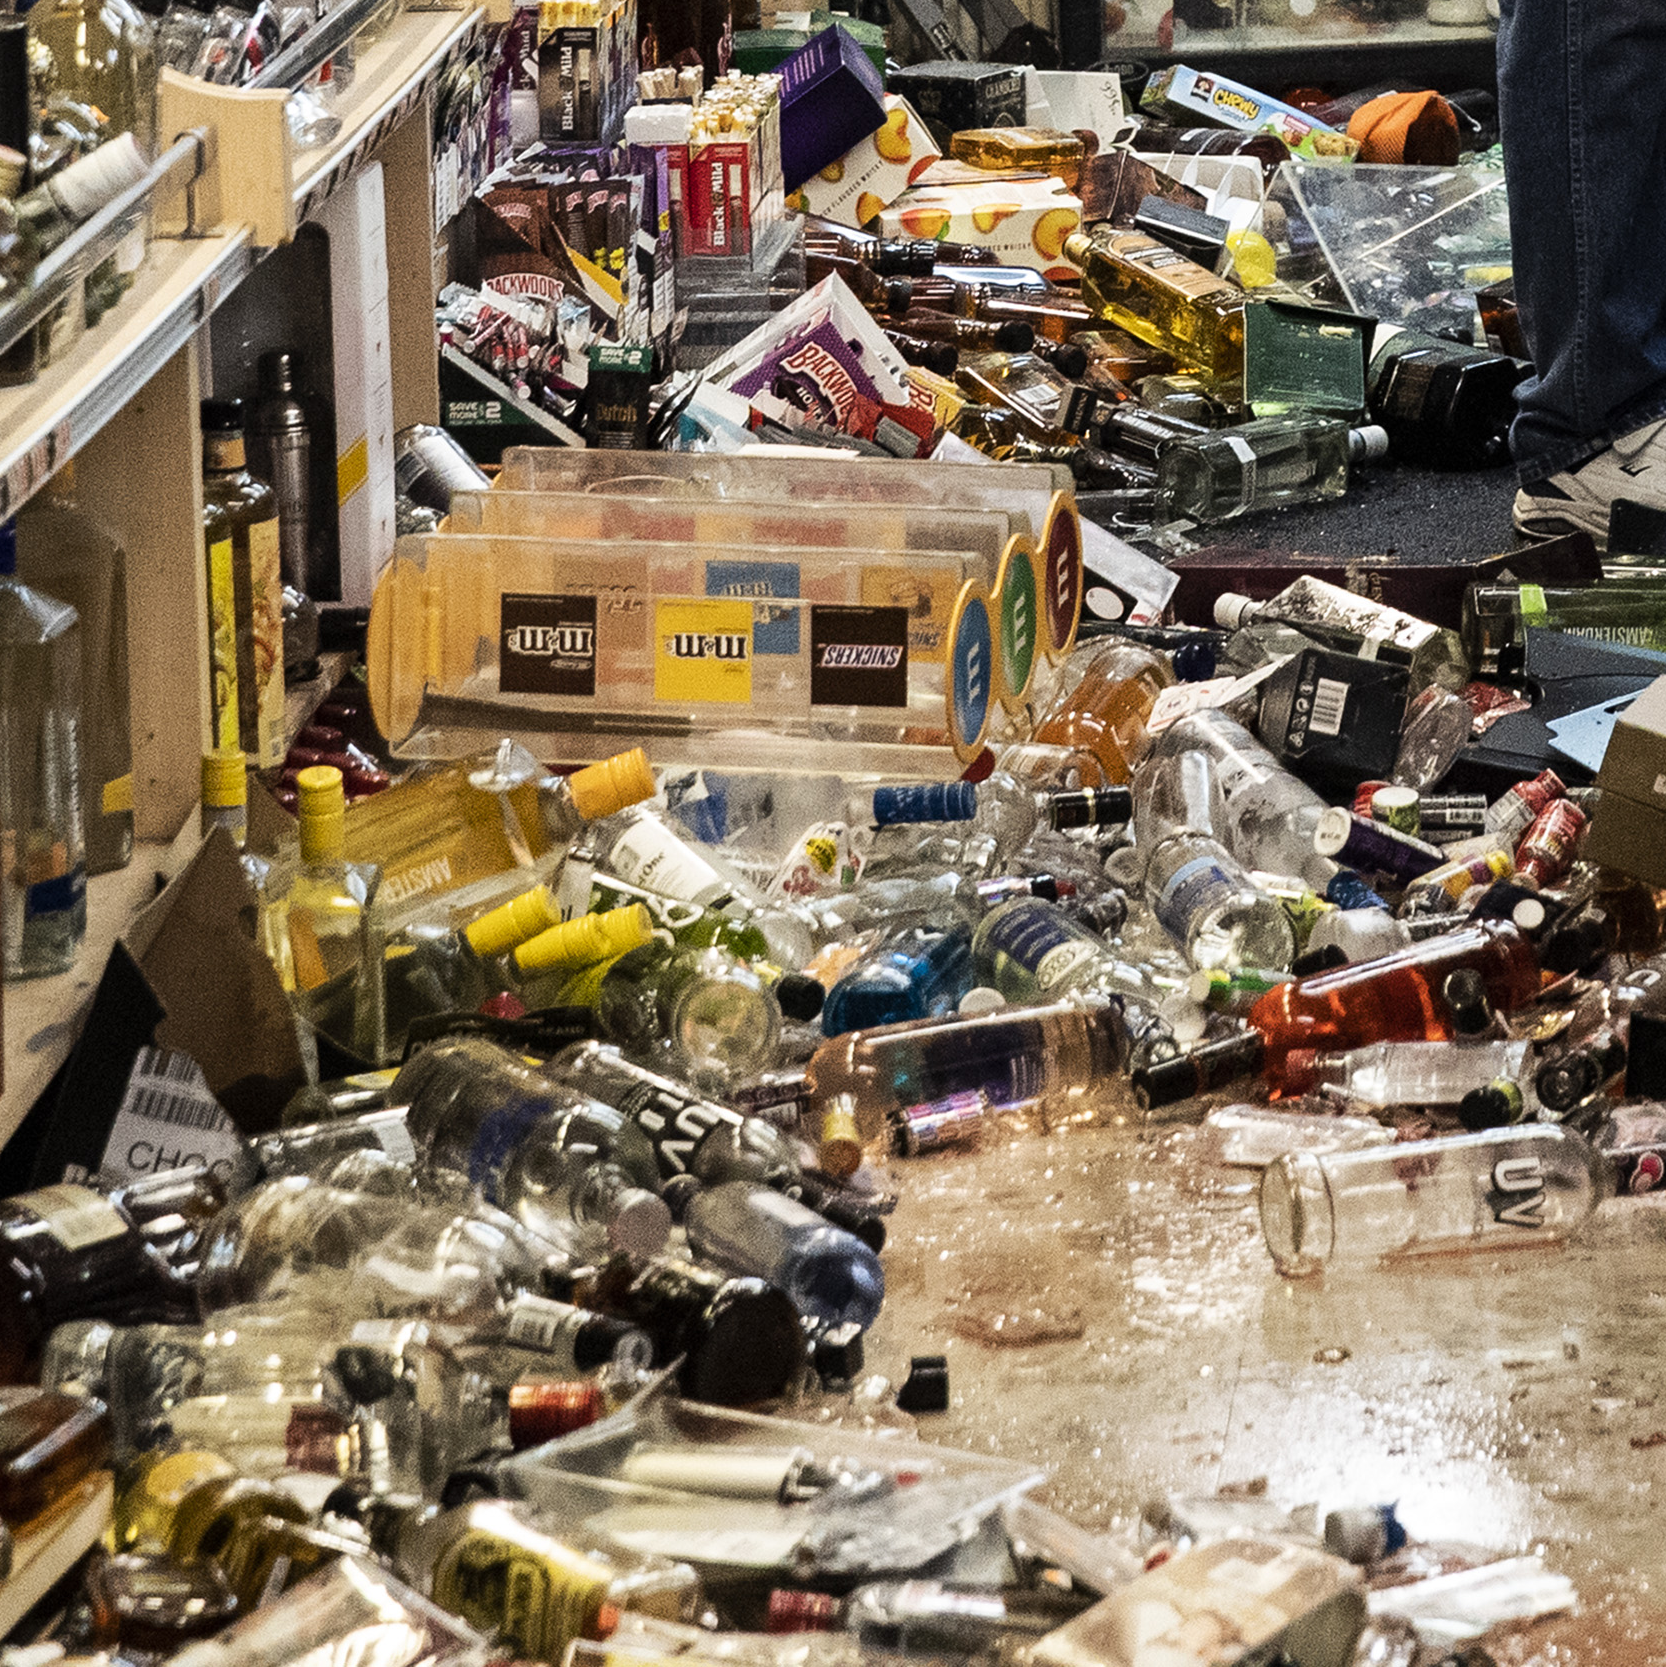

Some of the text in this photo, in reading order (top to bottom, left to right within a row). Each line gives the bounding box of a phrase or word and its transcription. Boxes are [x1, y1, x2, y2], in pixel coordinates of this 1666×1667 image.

[560, 45, 574, 131] Black Mild
[713, 162, 727, 247] Black Mild
[448, 401, 502, 419] SAVE 2
[448, 411, 479, 420] MORE
[824, 644, 903, 669] SNICKERS
[1491, 1155, 1547, 1228] UV
